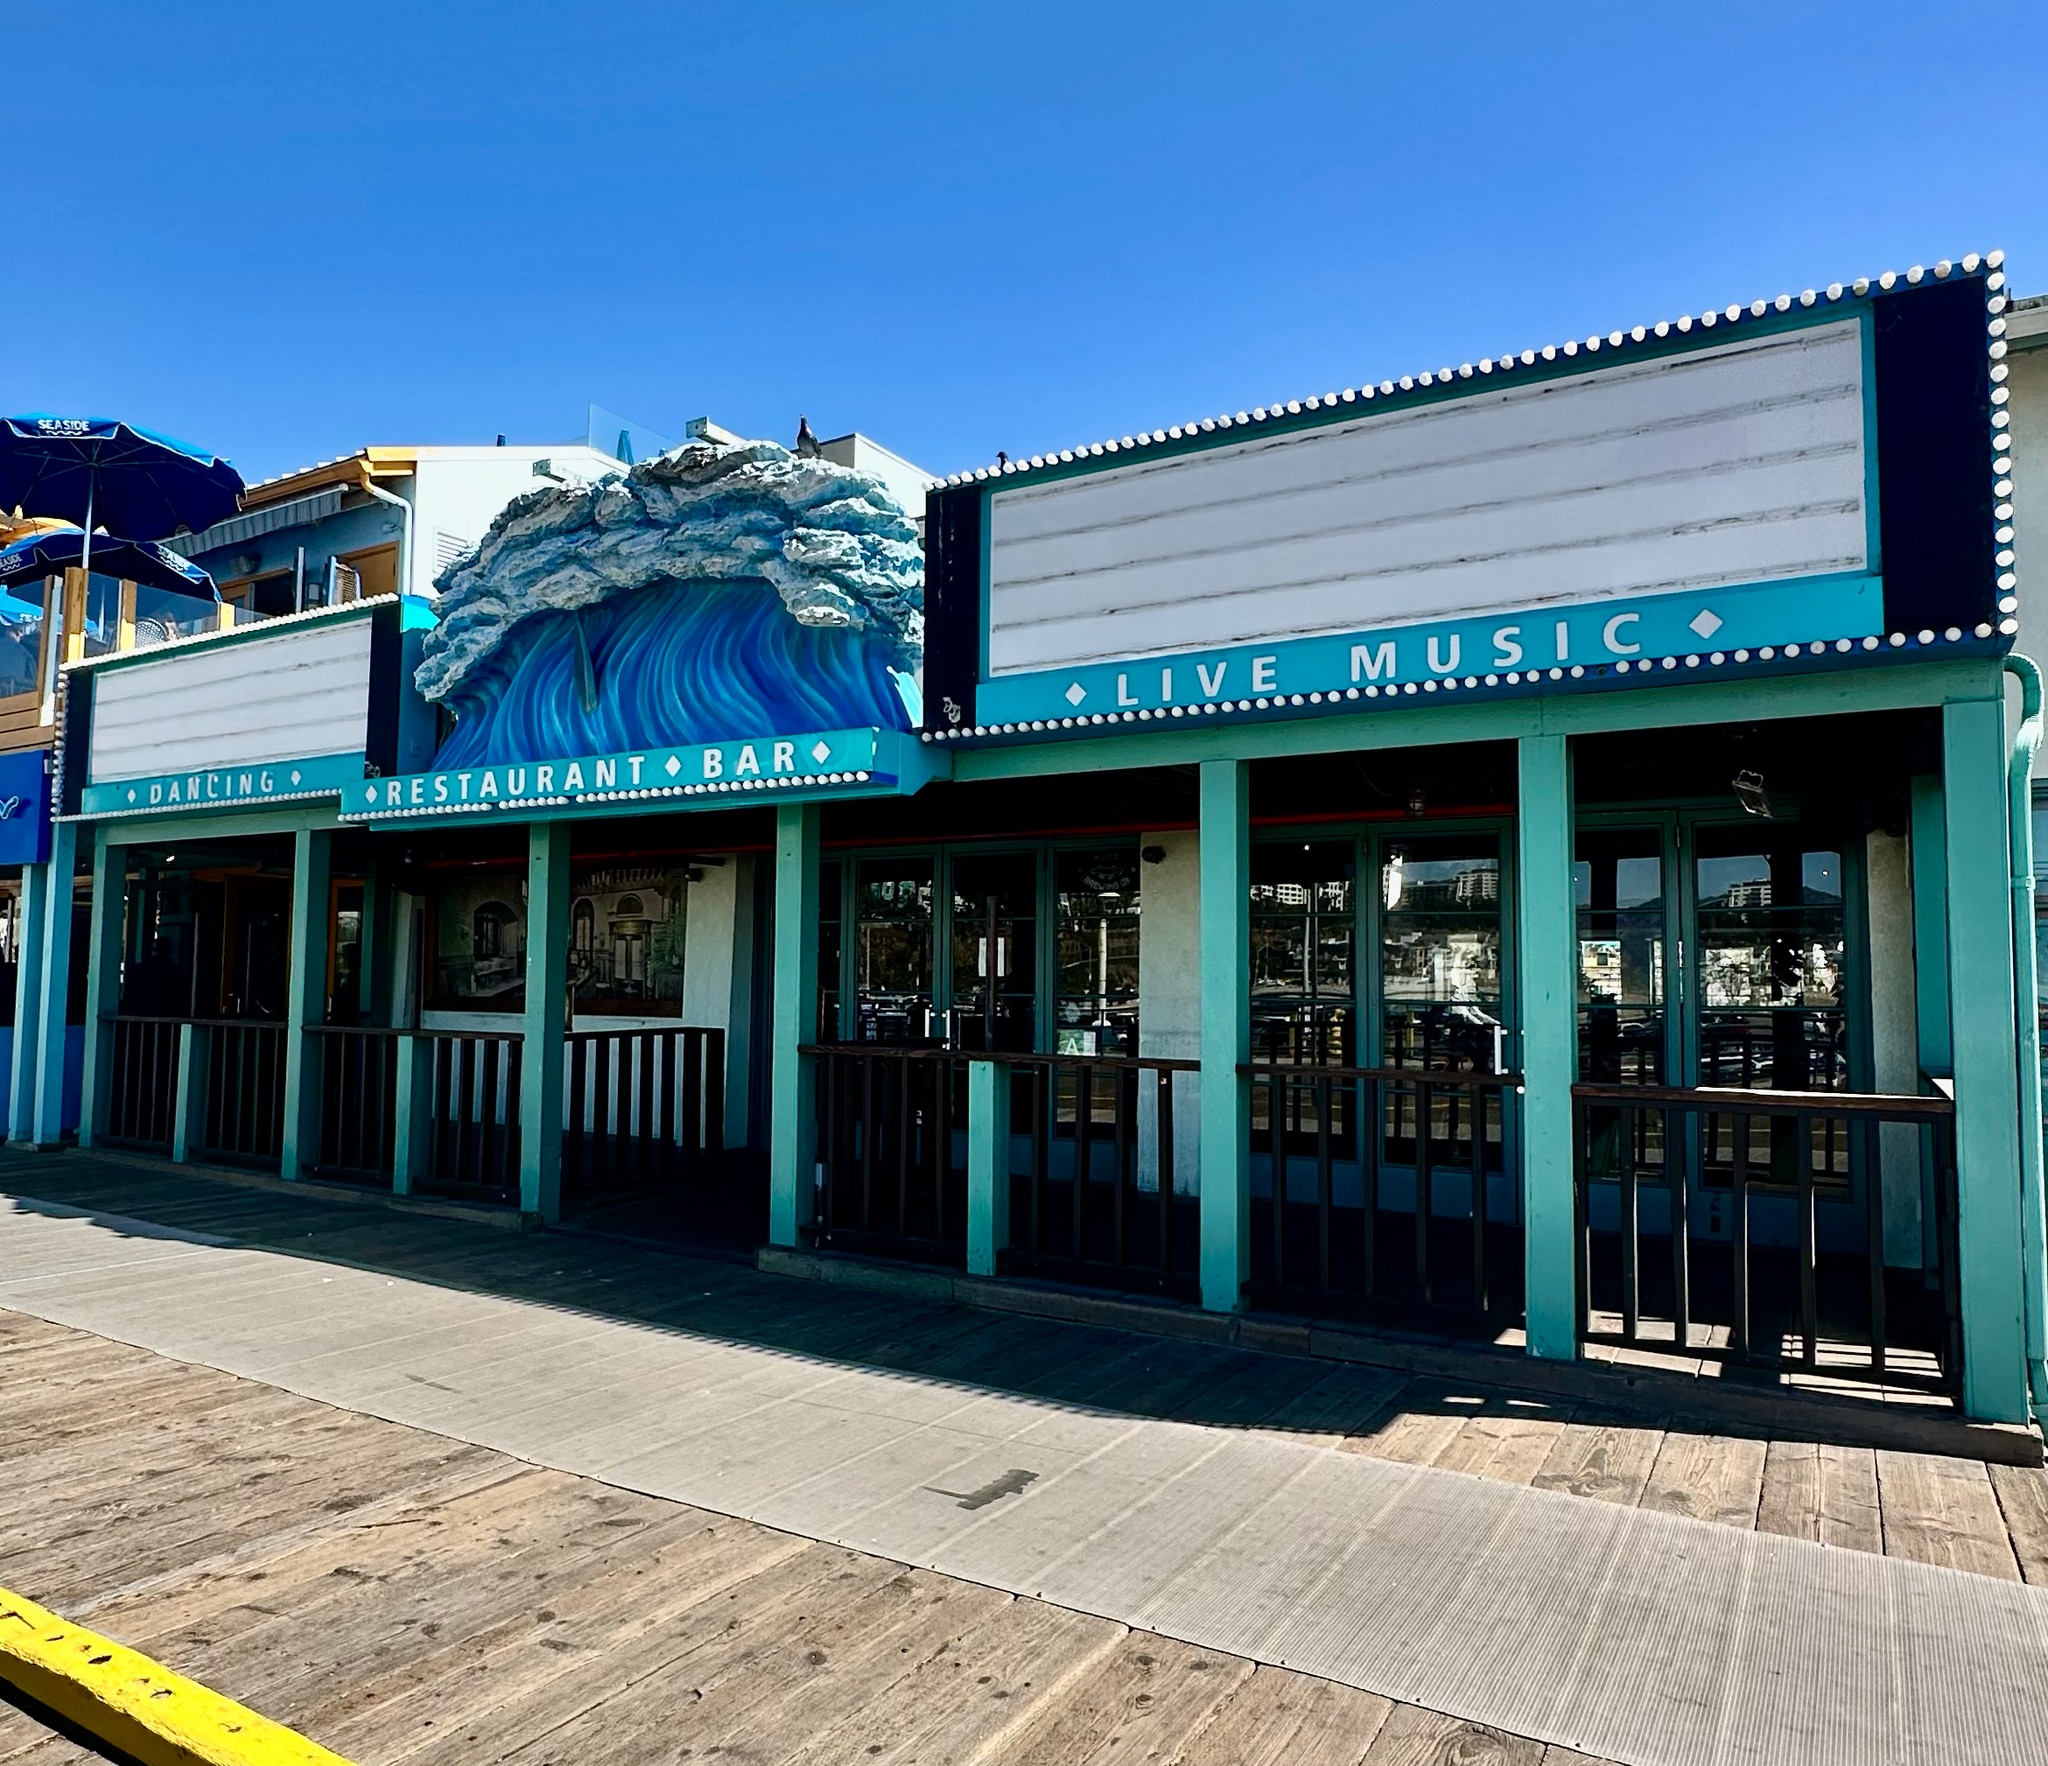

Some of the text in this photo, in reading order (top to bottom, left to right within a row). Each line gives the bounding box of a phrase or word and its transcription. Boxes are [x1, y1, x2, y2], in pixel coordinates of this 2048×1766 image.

[38, 419, 91, 432] SEASIDE
[1117, 612, 1641, 706] LIVE MUSIC
[150, 770, 274, 804] DANCING
[387, 741, 795, 807] RESTAURANT BAR
